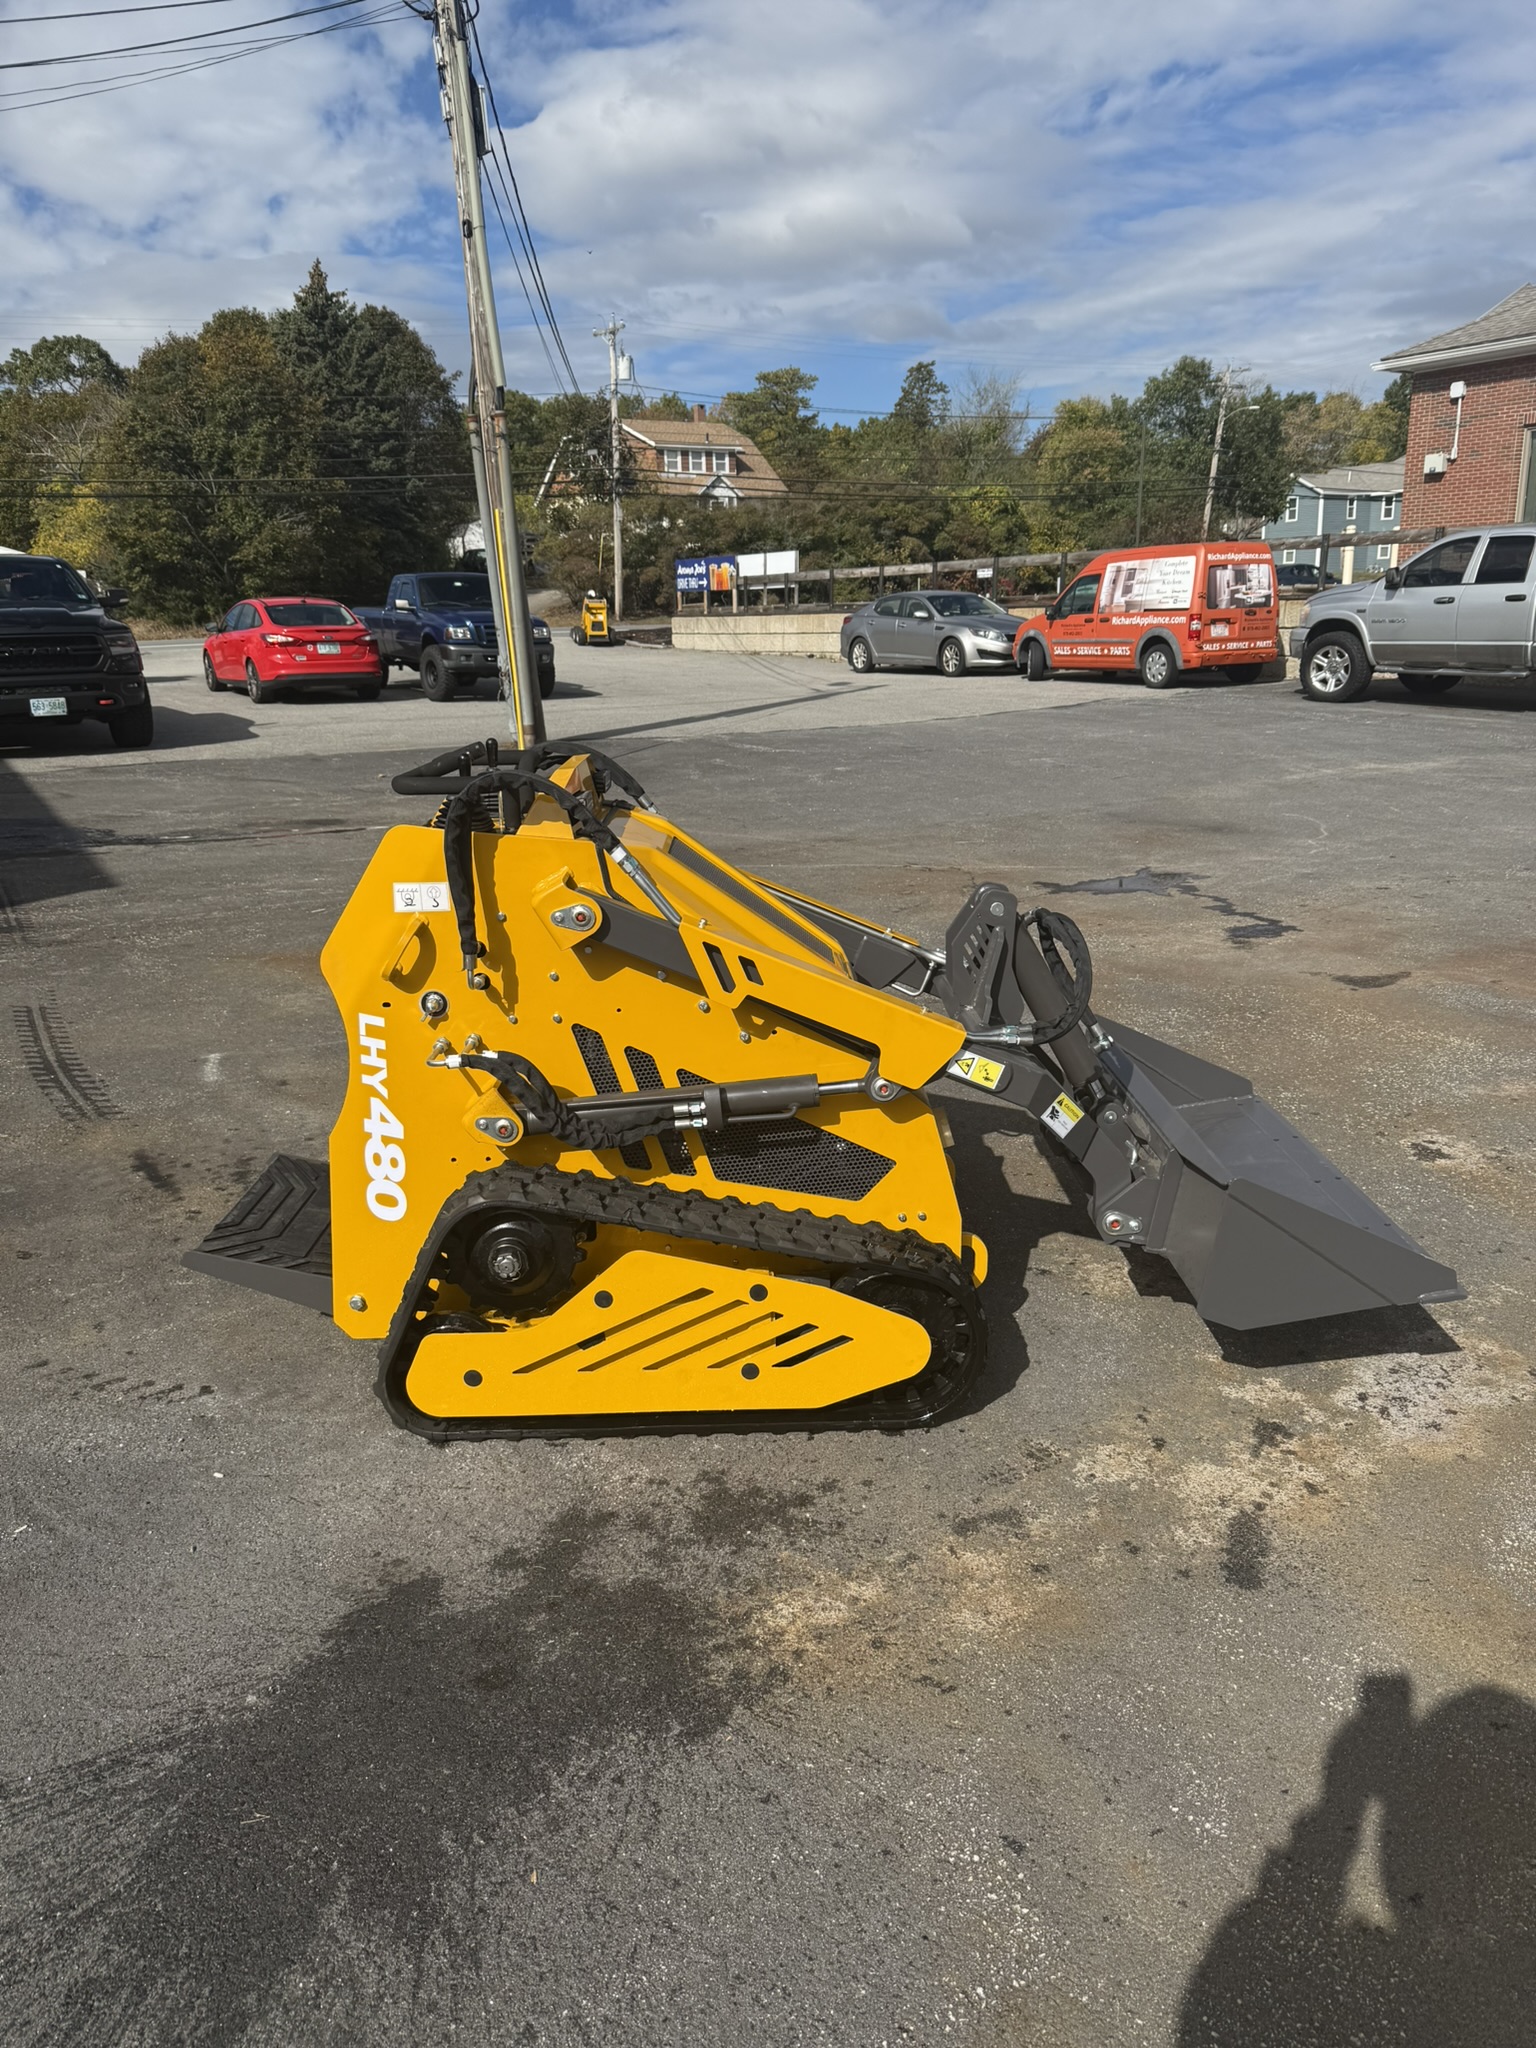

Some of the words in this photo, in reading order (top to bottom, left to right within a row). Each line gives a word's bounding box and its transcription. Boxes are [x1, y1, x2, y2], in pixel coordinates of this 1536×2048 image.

[1207, 553, 1271, 561] RichardAppliance.com
[1111, 616, 1186, 626] RichardAppliance.com
[1227, 641, 1248, 649] SERVICE
[1054, 646, 1071, 655] SALES
[1077, 646, 1101, 655] SERVICE
[1110, 646, 1130, 655] PARTS
